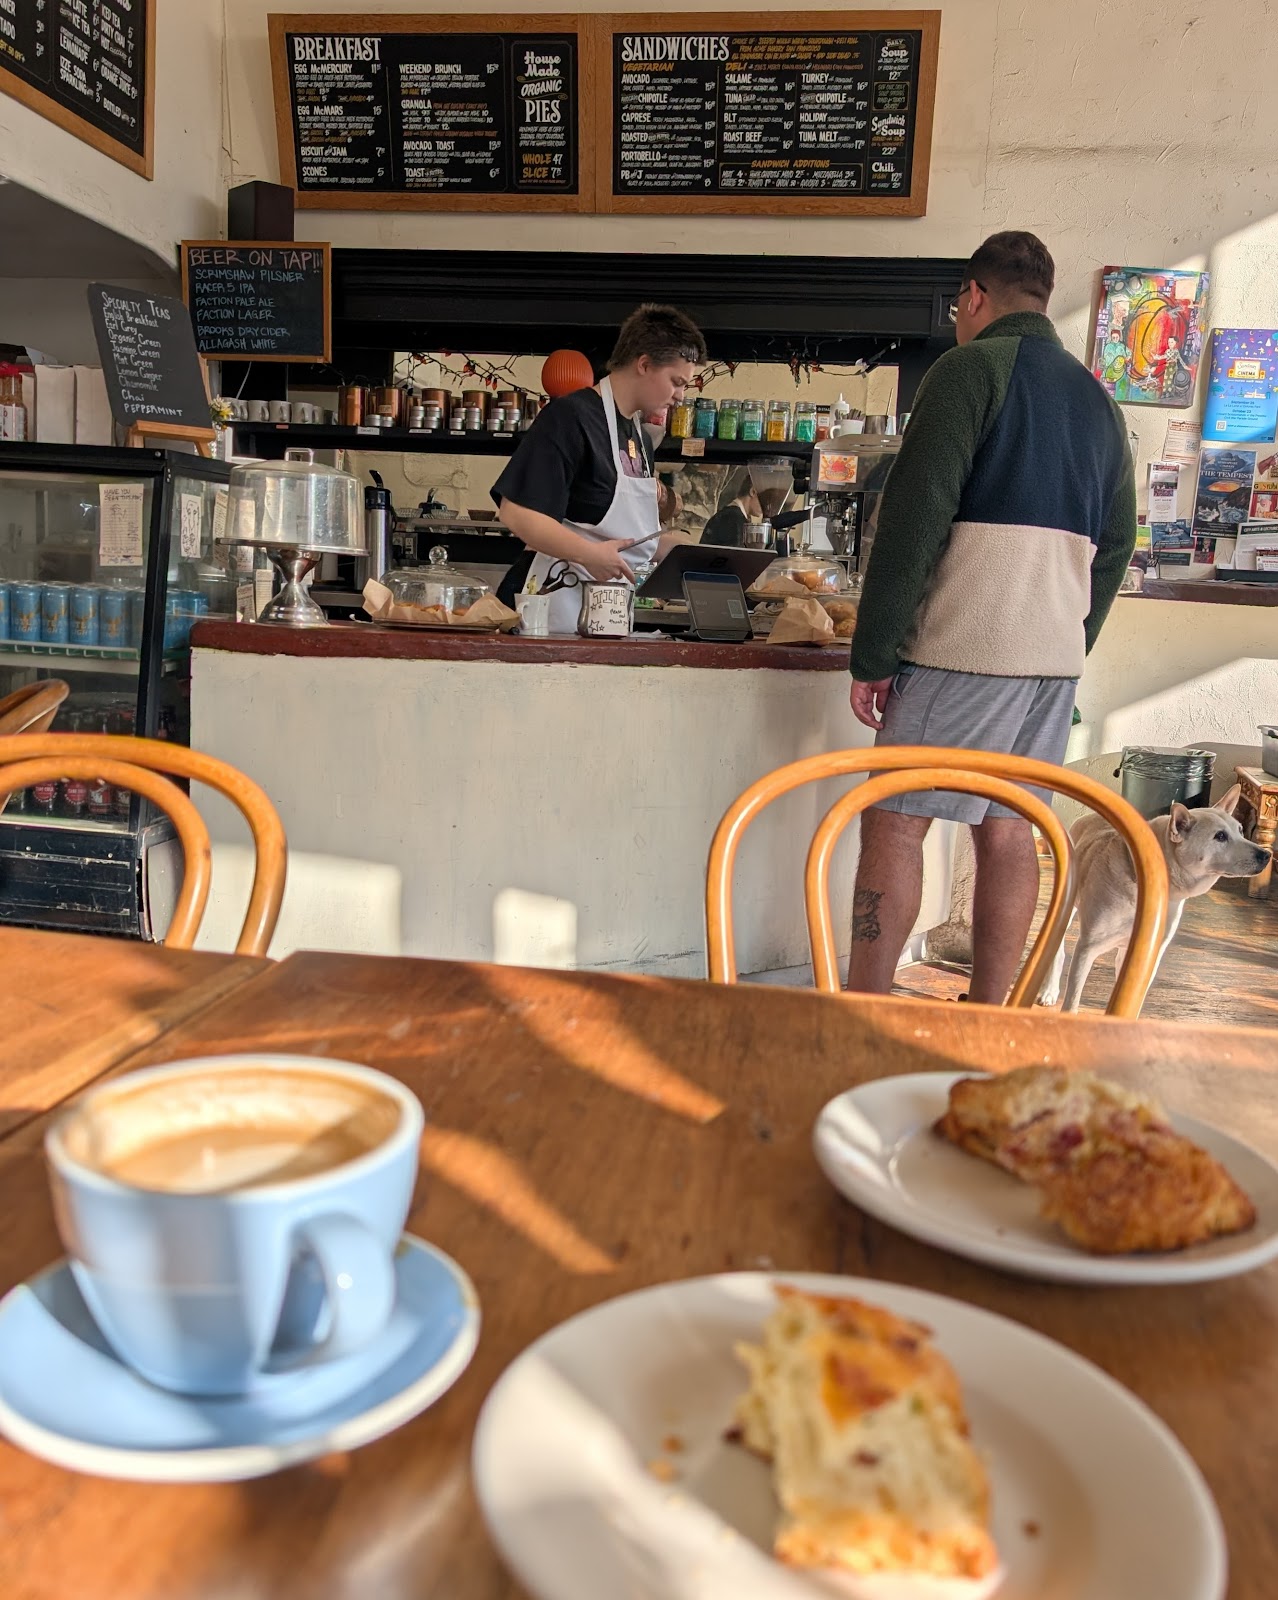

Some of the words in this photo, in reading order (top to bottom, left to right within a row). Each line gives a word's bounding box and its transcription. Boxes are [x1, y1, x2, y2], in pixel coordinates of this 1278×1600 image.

[112, 12, 120, 30] TEA
[60, 33, 88, 64] LEMONADE
[293, 37, 381, 61] BREAKFAST
[622, 37, 729, 61] SANDWICHES
[881, 47, 908, 58] Soup
[524, 51, 561, 64] House
[294, 64, 307, 73] EGG
[311, 64, 352, 73] McMERCURY
[399, 64, 432, 74] WEEKEND
[435, 64, 461, 74] BRUNCH
[525, 64, 560, 77] Made
[622, 63, 674, 72] VEGETARIAN
[725, 63, 748, 71] DELI
[74, 65, 86, 83] SODA
[621, 74, 650, 84] AVOCADO
[725, 74, 752, 84] SALAME
[802, 73, 830, 83] TURKEY
[60, 69, 87, 95] SPARKLING
[101, 65, 119, 88] ORANGE
[119, 76, 131, 96] JUICE
[521, 79, 562, 97] ORGANIC
[638, 93, 668, 104] CHIPOTLE
[725, 93, 742, 103] TUNA
[816, 93, 847, 103] CHIPOTLE
[298, 106, 310, 115] EGG
[314, 105, 343, 115] McMARS
[401, 100, 432, 109] GRANOLA
[525, 100, 561, 123] PIES
[621, 113, 651, 122] CAPRESE
[724, 113, 737, 123] BLT
[800, 113, 828, 123] HOLIDAY
[872, 114, 905, 132] Sandwich
[621, 133, 648, 142] ROASTED
[723, 132, 744, 142] ROAST
[746, 132, 762, 142] BEEF
[799, 132, 817, 142] TUNA
[819, 132, 838, 142] MELT
[881, 126, 905, 139] Soup
[301, 146, 324, 156] BISCUIT
[332, 146, 347, 156] JAM
[403, 141, 432, 150] AVOCADO
[436, 141, 455, 150] TOAST
[522, 154, 551, 164] WHOLE
[552, 154, 562, 164] 47
[621, 151, 660, 161] PORTOBELLO
[751, 160, 790, 168] SANDWICH
[793, 160, 830, 168] ADDITIONS
[872, 162, 895, 172] Chili
[302, 166, 327, 176] SCONES
[377, 168, 384, 176] 5
[404, 168, 425, 177] TOAST
[523, 167, 548, 178] SLICE
[189, 248, 244, 266] BEER
[249, 250, 272, 266] ON
[196, 269, 254, 280] SCRIMSHAW
[260, 270, 304, 282] PILSNER
[196, 283, 225, 294] RACER
[227, 283, 235, 293] 5
[240, 283, 255, 294] IPA
[195, 297, 233, 307] FACTION
[235, 297, 256, 306] PALE
[259, 298, 276, 307] ALE
[103, 307, 124, 321] English
[126, 312, 159, 328] Breakfast
[197, 309, 234, 322] FACTION
[238, 310, 275, 320] LAGER
[106, 319, 118, 330] Earl
[121, 321, 137, 335] Grey
[197, 326, 234, 336] BROOKS
[238, 327, 260, 336] DRY
[261, 327, 290, 337] CIDER
[108, 329, 136, 344] Organic
[138, 334, 161, 348] Green
[110, 340, 138, 356] Jasmine
[137, 345, 160, 359] Green
[199, 338, 247, 351] ALLAGASH
[251, 339, 277, 349] WHITE
[113, 353, 128, 365] Mint
[130, 354, 153, 369] Green
[116, 364, 138, 378] Lemon
[139, 367, 162, 382] Ginger
[119, 376, 159, 391] Chamomile
[122, 389, 144, 402] Chai
[124, 403, 183, 416] PEPPERMINT
[1217, 471, 1254, 479] TEMPEST
[593, 590, 626, 606] TIPS
